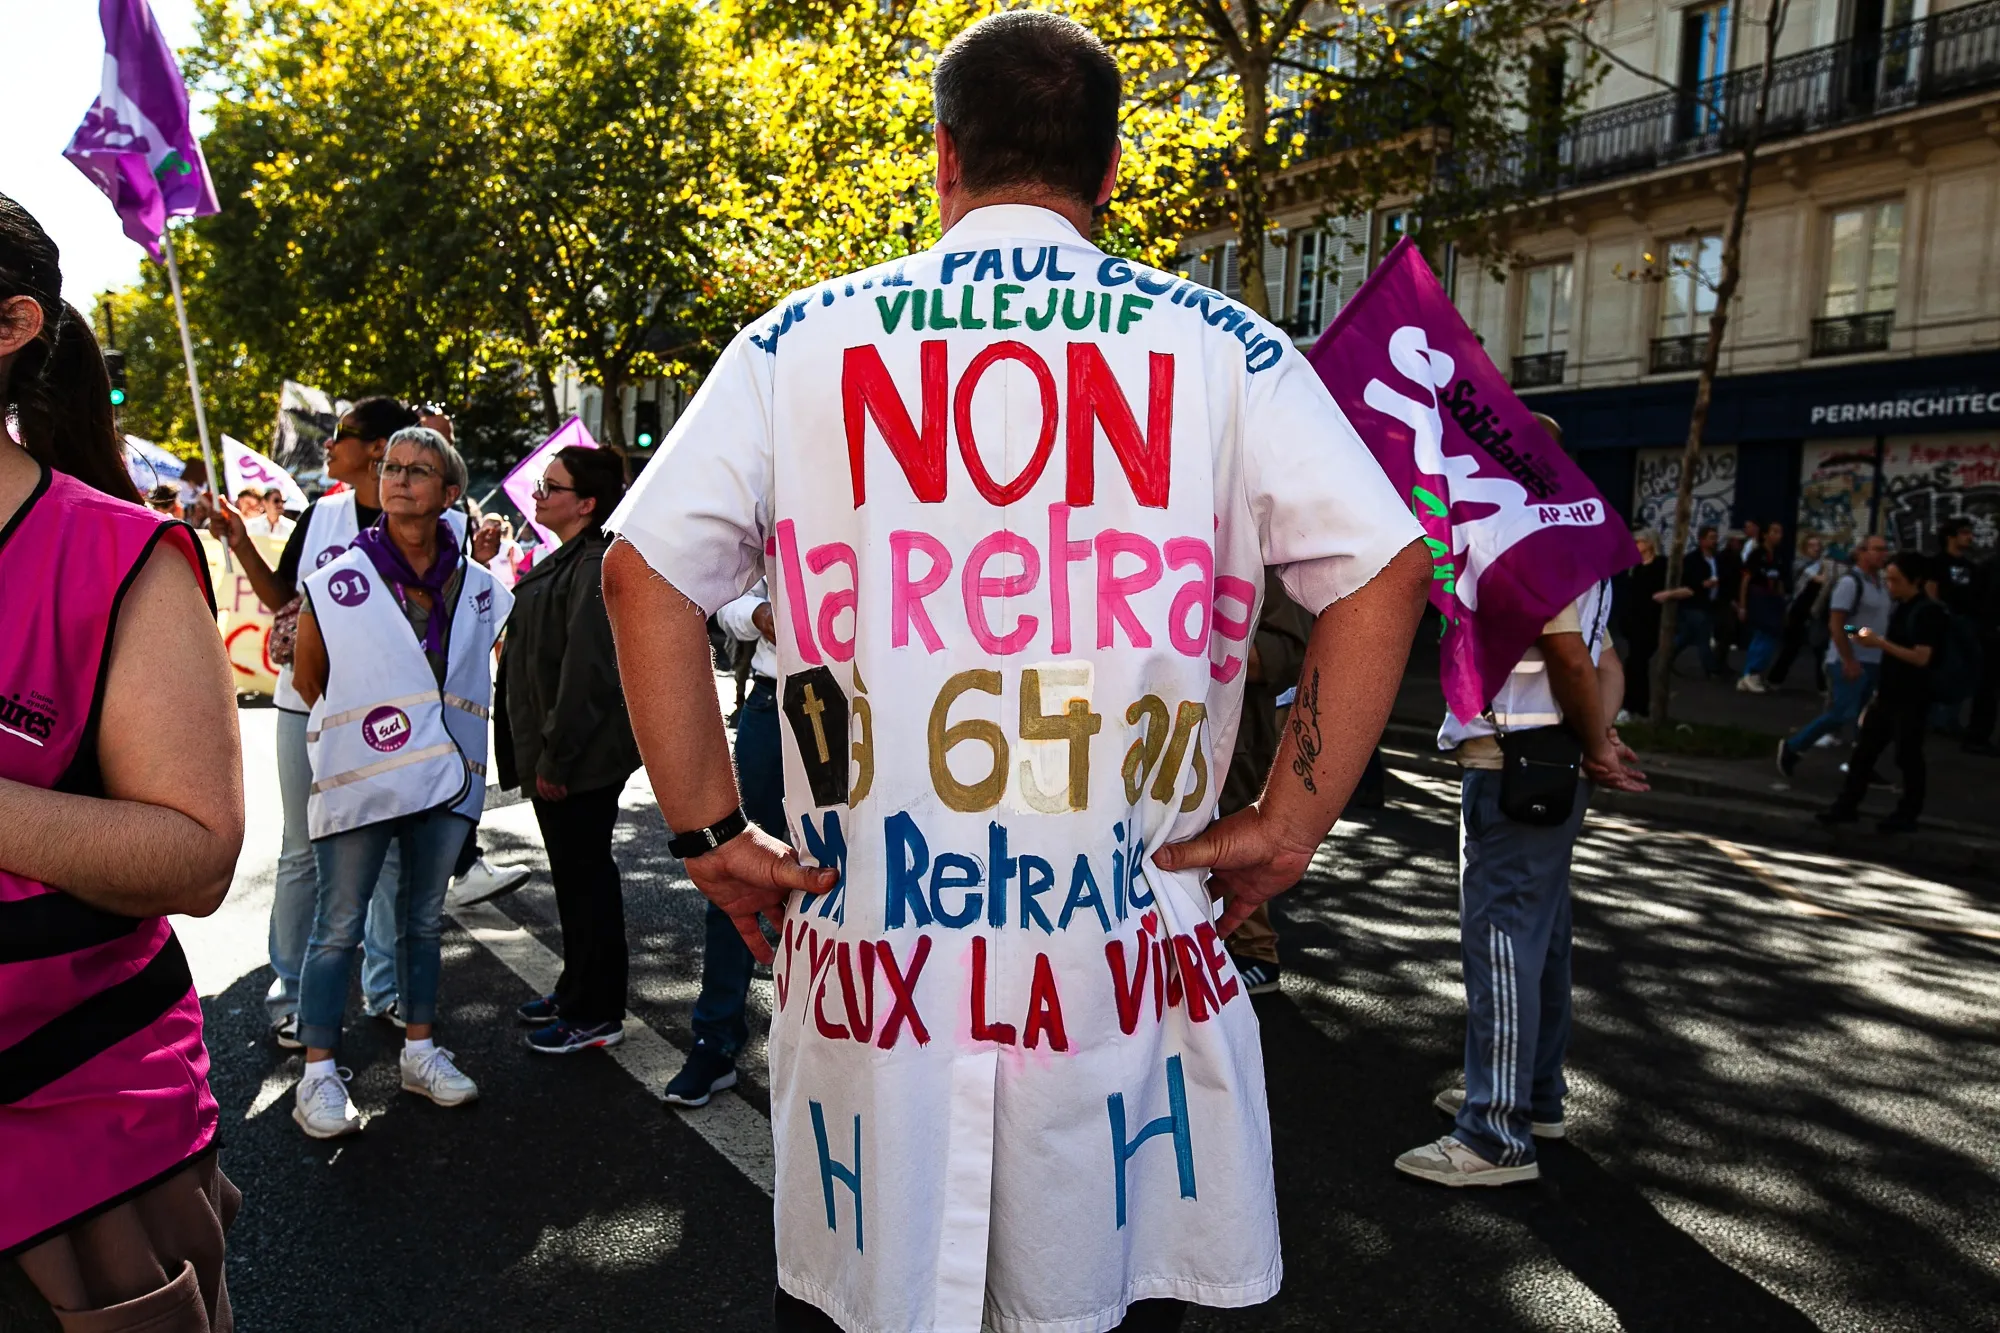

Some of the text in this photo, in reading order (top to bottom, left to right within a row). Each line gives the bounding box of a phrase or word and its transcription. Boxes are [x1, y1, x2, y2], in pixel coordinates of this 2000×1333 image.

[875, 283, 1153, 335] VILLEJUIF
[940, 246, 1283, 374] PAUL GUIRAUD
[842, 340, 1174, 510] NON
[1440, 379, 1556, 499] Solidaires
[1811, 391, 2000, 424] PERMARCHITEC
[1538, 502, 1597, 524] AP-HP
[331, 576, 368, 601] 91
[776, 518, 859, 665] la
[971, 935, 1069, 1052] LA
